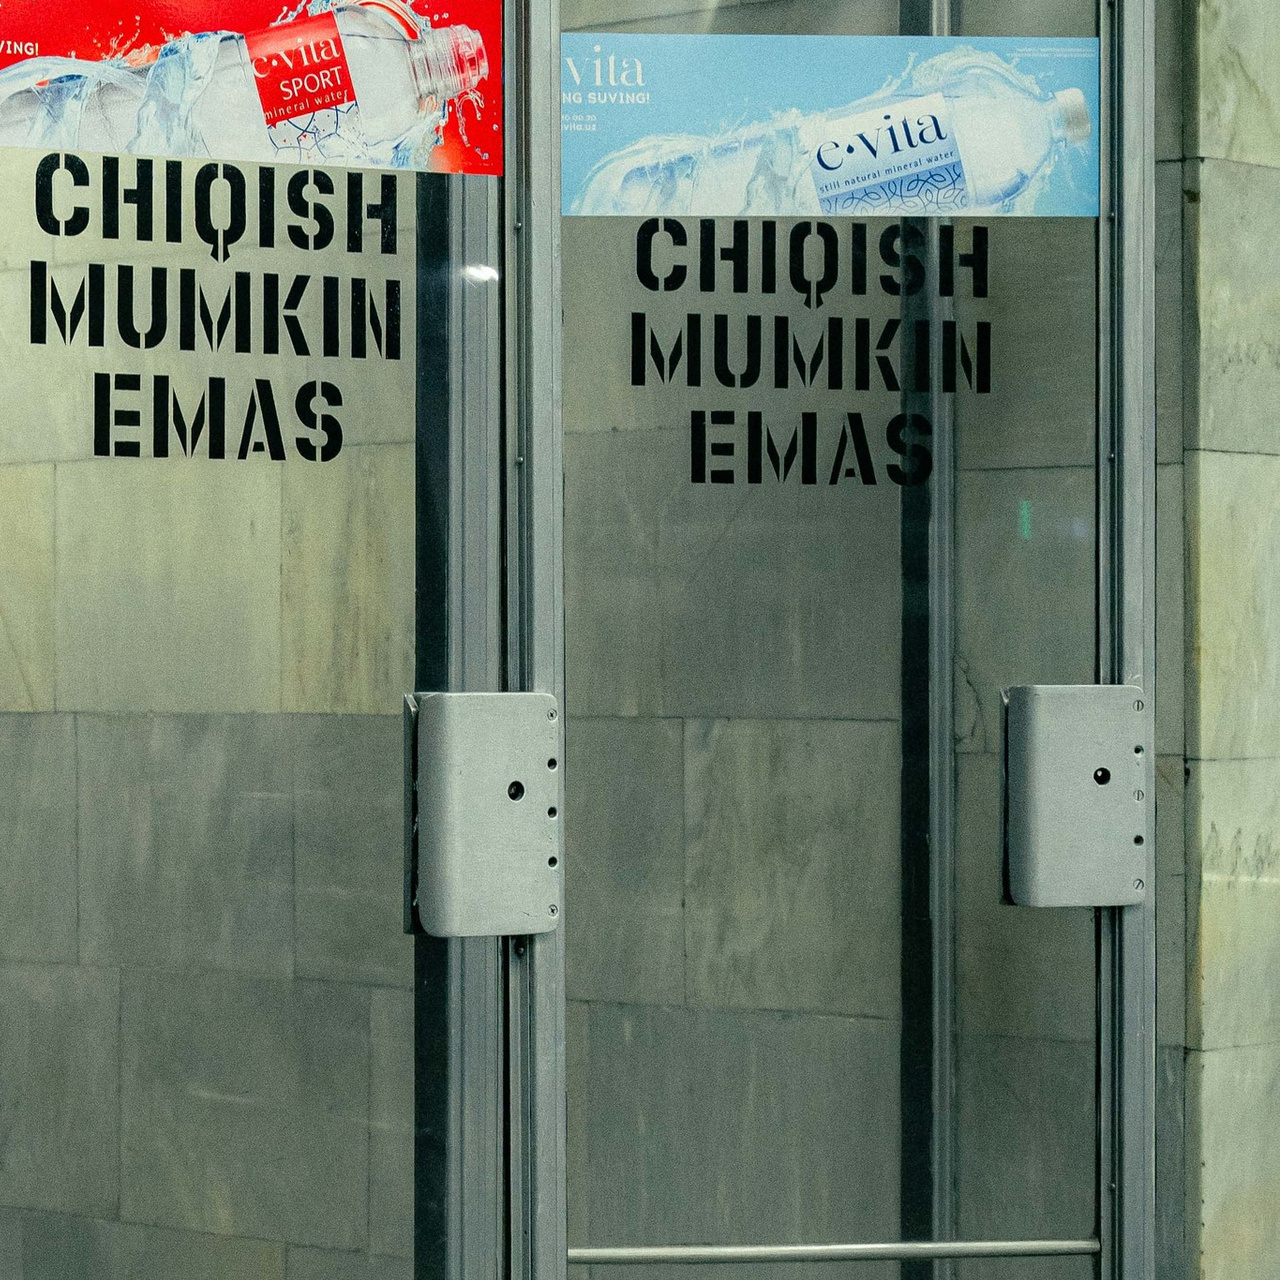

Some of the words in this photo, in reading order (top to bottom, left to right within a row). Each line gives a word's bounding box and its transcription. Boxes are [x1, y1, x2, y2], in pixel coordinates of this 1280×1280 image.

[265, 99, 311, 121] mineral
[314, 89, 349, 106] water
[280, 66, 343, 100] SPORT
[587, 92, 650, 104] SUVING!
[35, 152, 397, 263] CHIQISH
[820, 181, 840, 193] still
[844, 170, 881, 187] natural
[884, 158, 923, 175] mineral
[926, 151, 955, 164] water
[636, 218, 988, 309] CHIQISH
[30, 260, 401, 360] MUMKIN
[631, 312, 991, 394] MUMKIN
[93, 372, 343, 462] EMAS
[690, 410, 933, 487] EMAS
